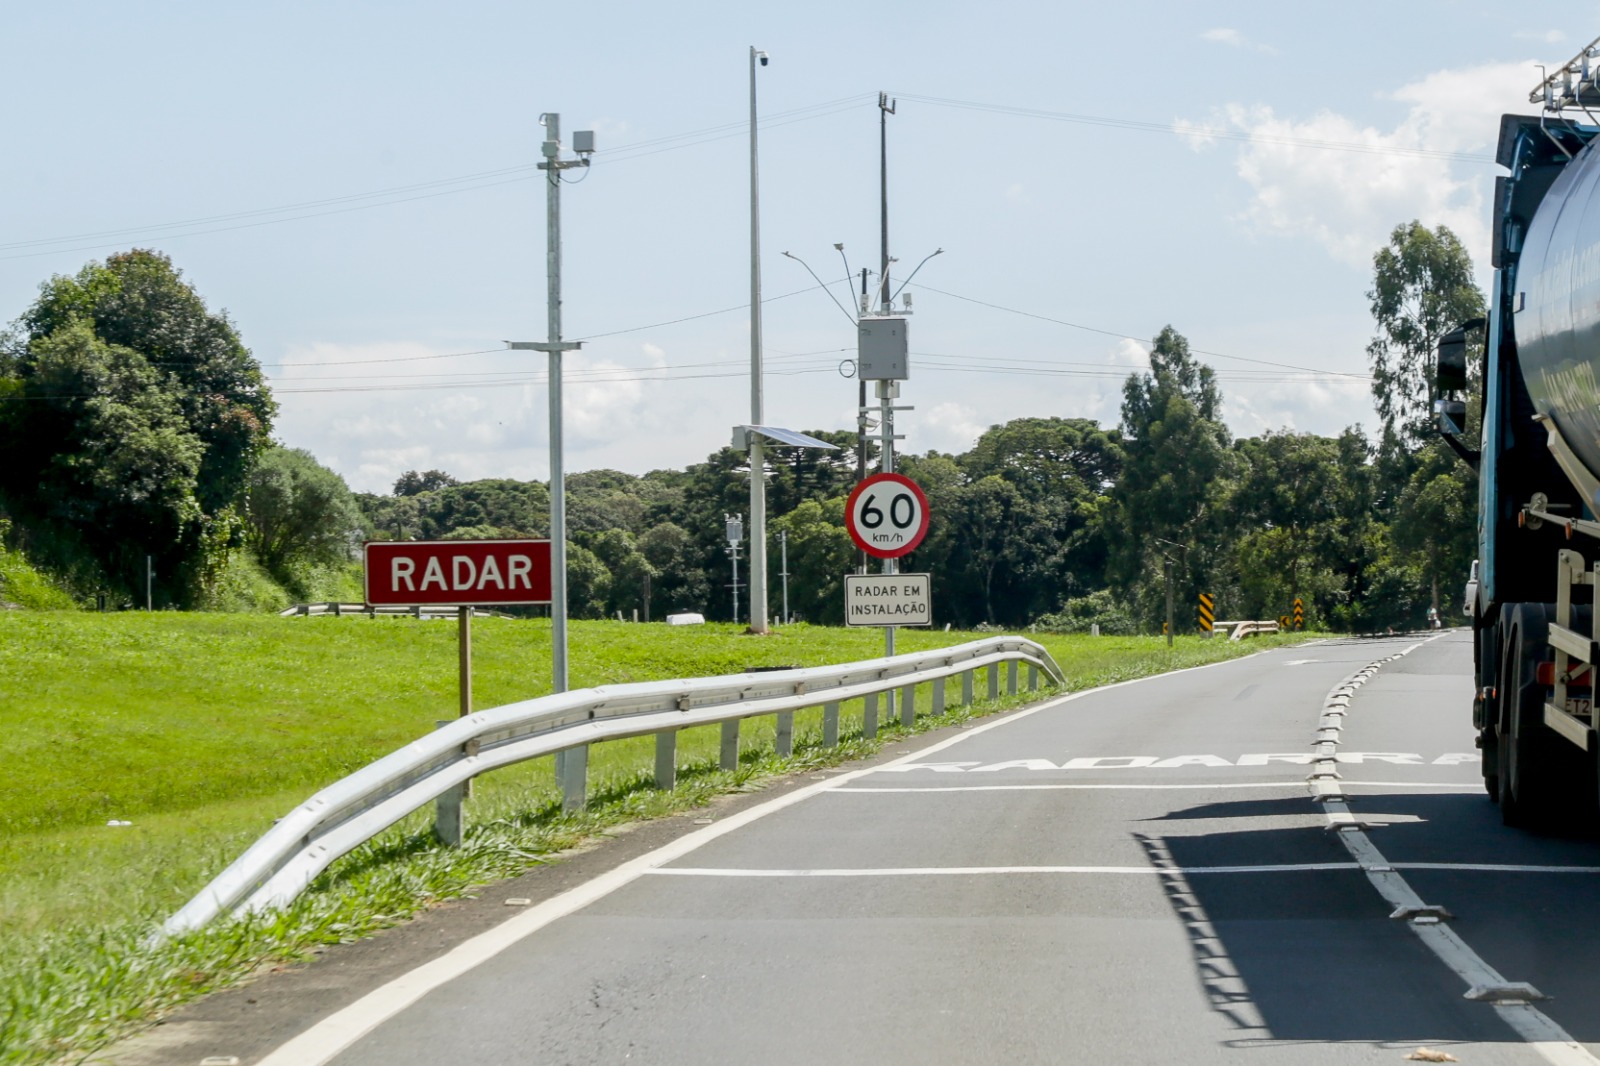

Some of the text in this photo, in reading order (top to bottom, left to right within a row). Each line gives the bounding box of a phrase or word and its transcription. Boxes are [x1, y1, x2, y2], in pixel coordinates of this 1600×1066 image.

[860, 493, 915, 530] 60
[872, 533, 903, 543] km/h
[391, 554, 533, 592] RADAR
[855, 585, 920, 597] RADAR EM
[851, 601, 926, 616] INSTALAÇÃO
[881, 753, 1316, 772] RADAR
